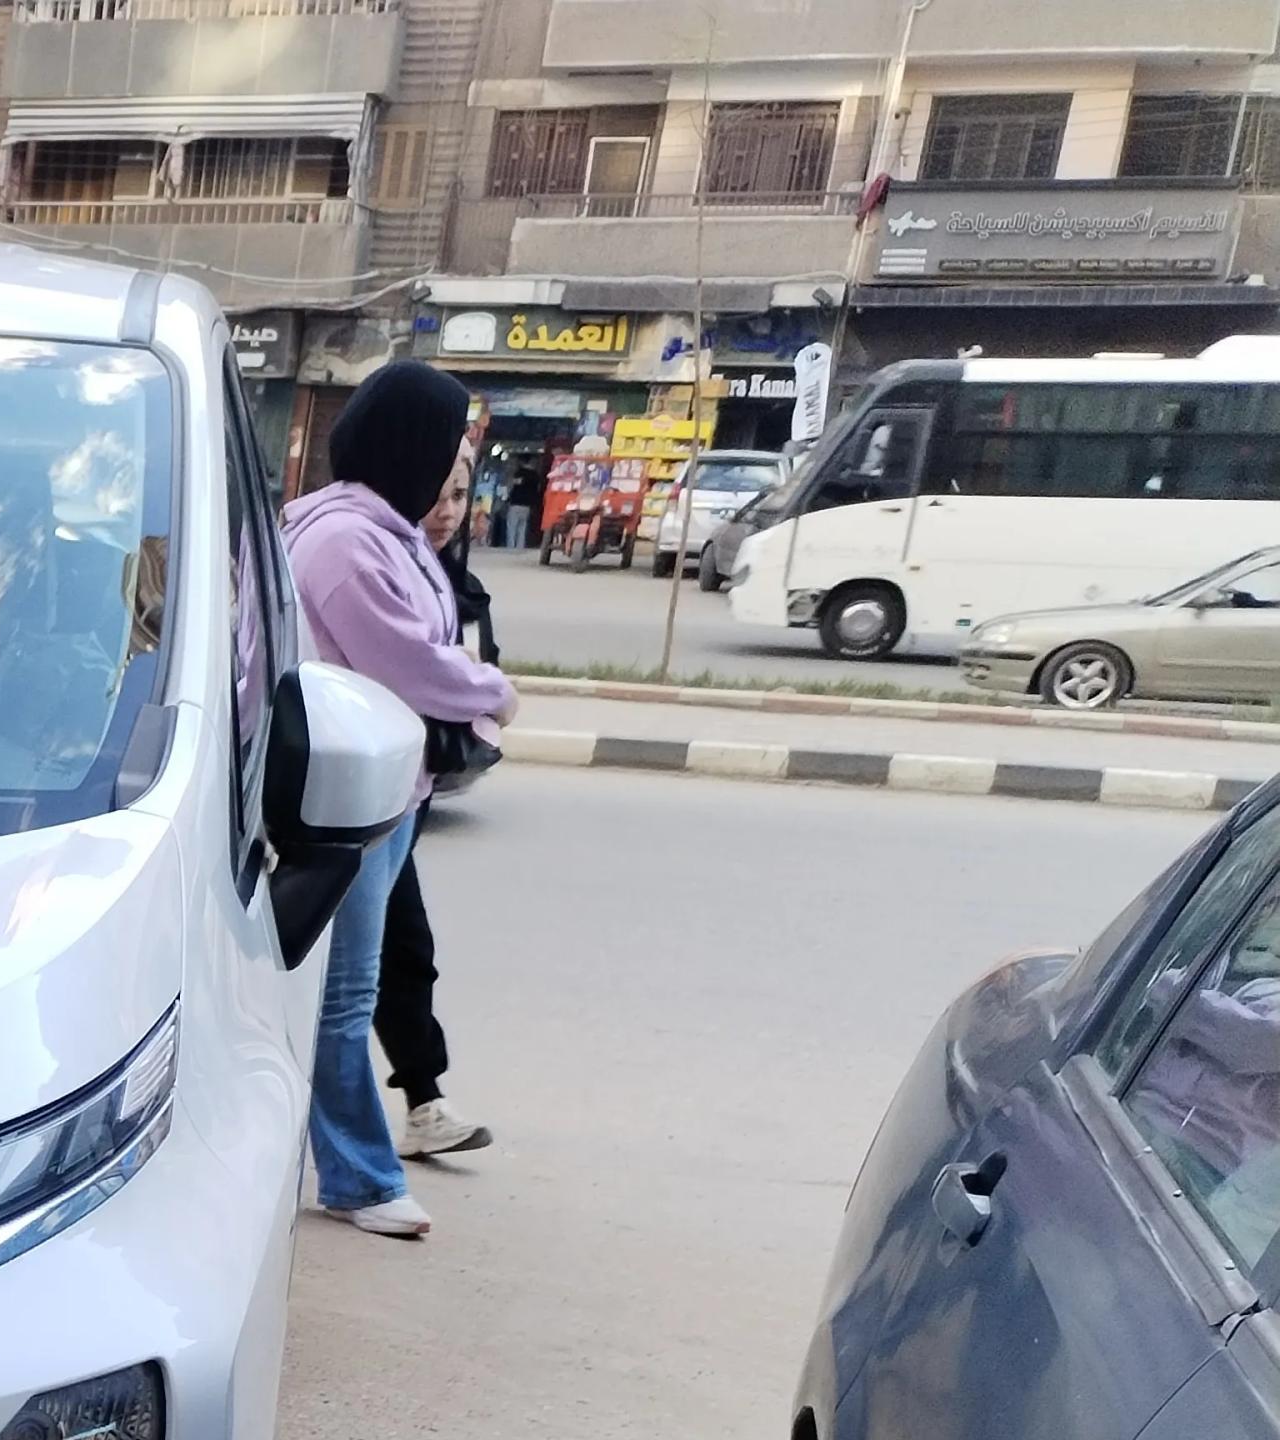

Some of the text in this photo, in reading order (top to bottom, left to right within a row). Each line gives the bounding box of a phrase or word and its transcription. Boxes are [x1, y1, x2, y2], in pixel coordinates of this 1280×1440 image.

[946, 210, 1030, 239] للسياحة
[1148, 209, 1228, 239] النسيم
[506, 313, 628, 351] العمدة
[748, 373, 798, 398] Kama
